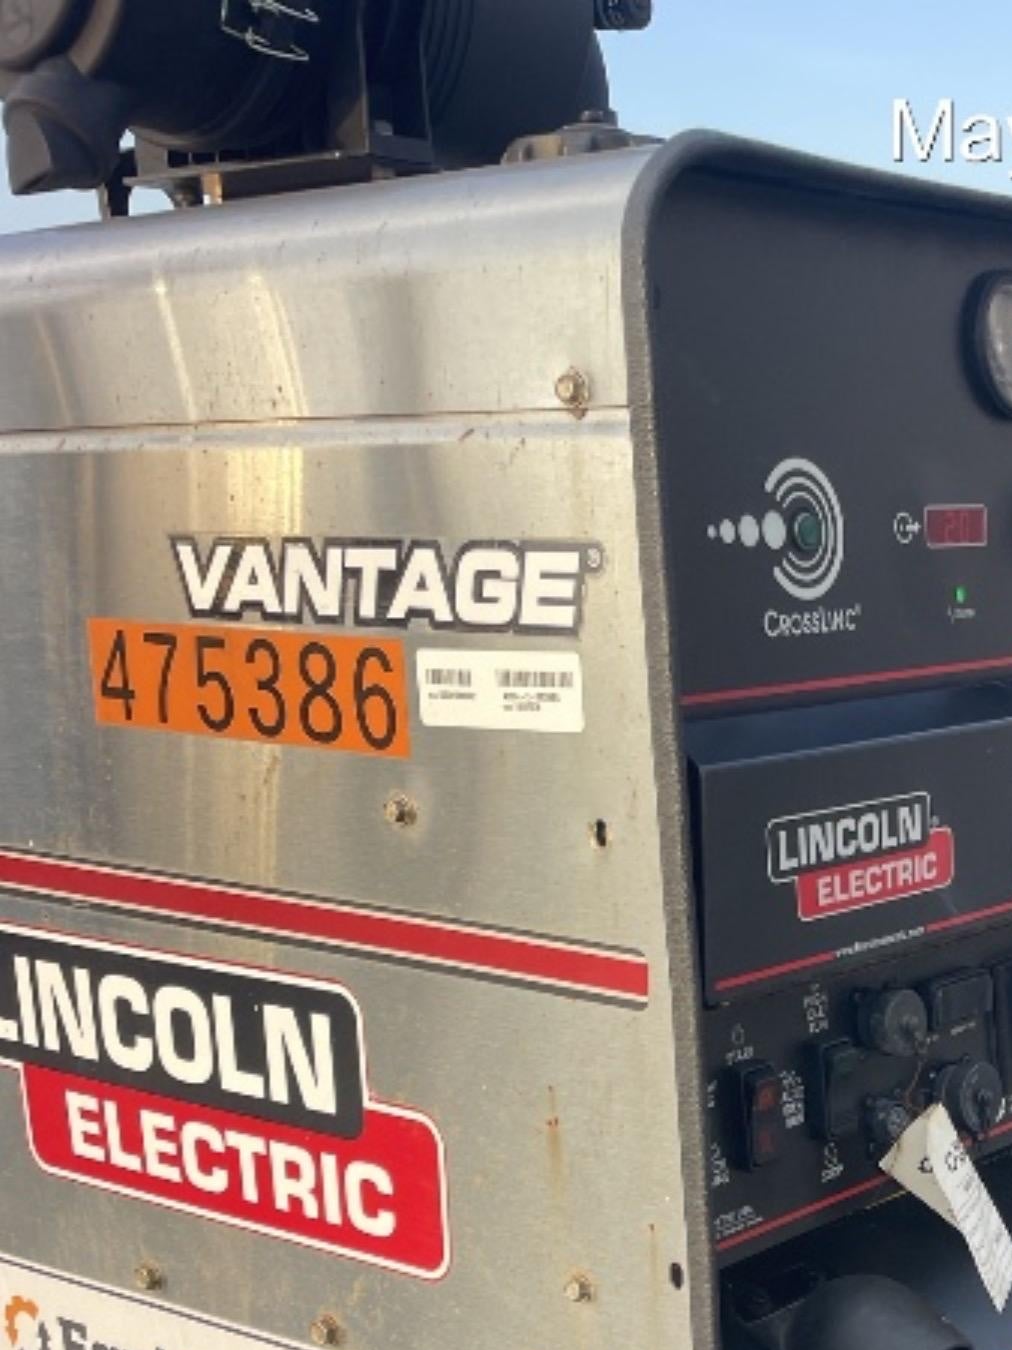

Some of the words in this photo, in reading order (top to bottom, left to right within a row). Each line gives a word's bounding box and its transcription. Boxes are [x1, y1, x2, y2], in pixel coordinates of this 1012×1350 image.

[174, 542, 582, 629] VANTAGE
[100, 629, 397, 751] 475386
[778, 803, 922, 871] LINCOLN
[816, 852, 938, 907] ELECTRIC
[64, 1090, 396, 1237] ELECTRIC
